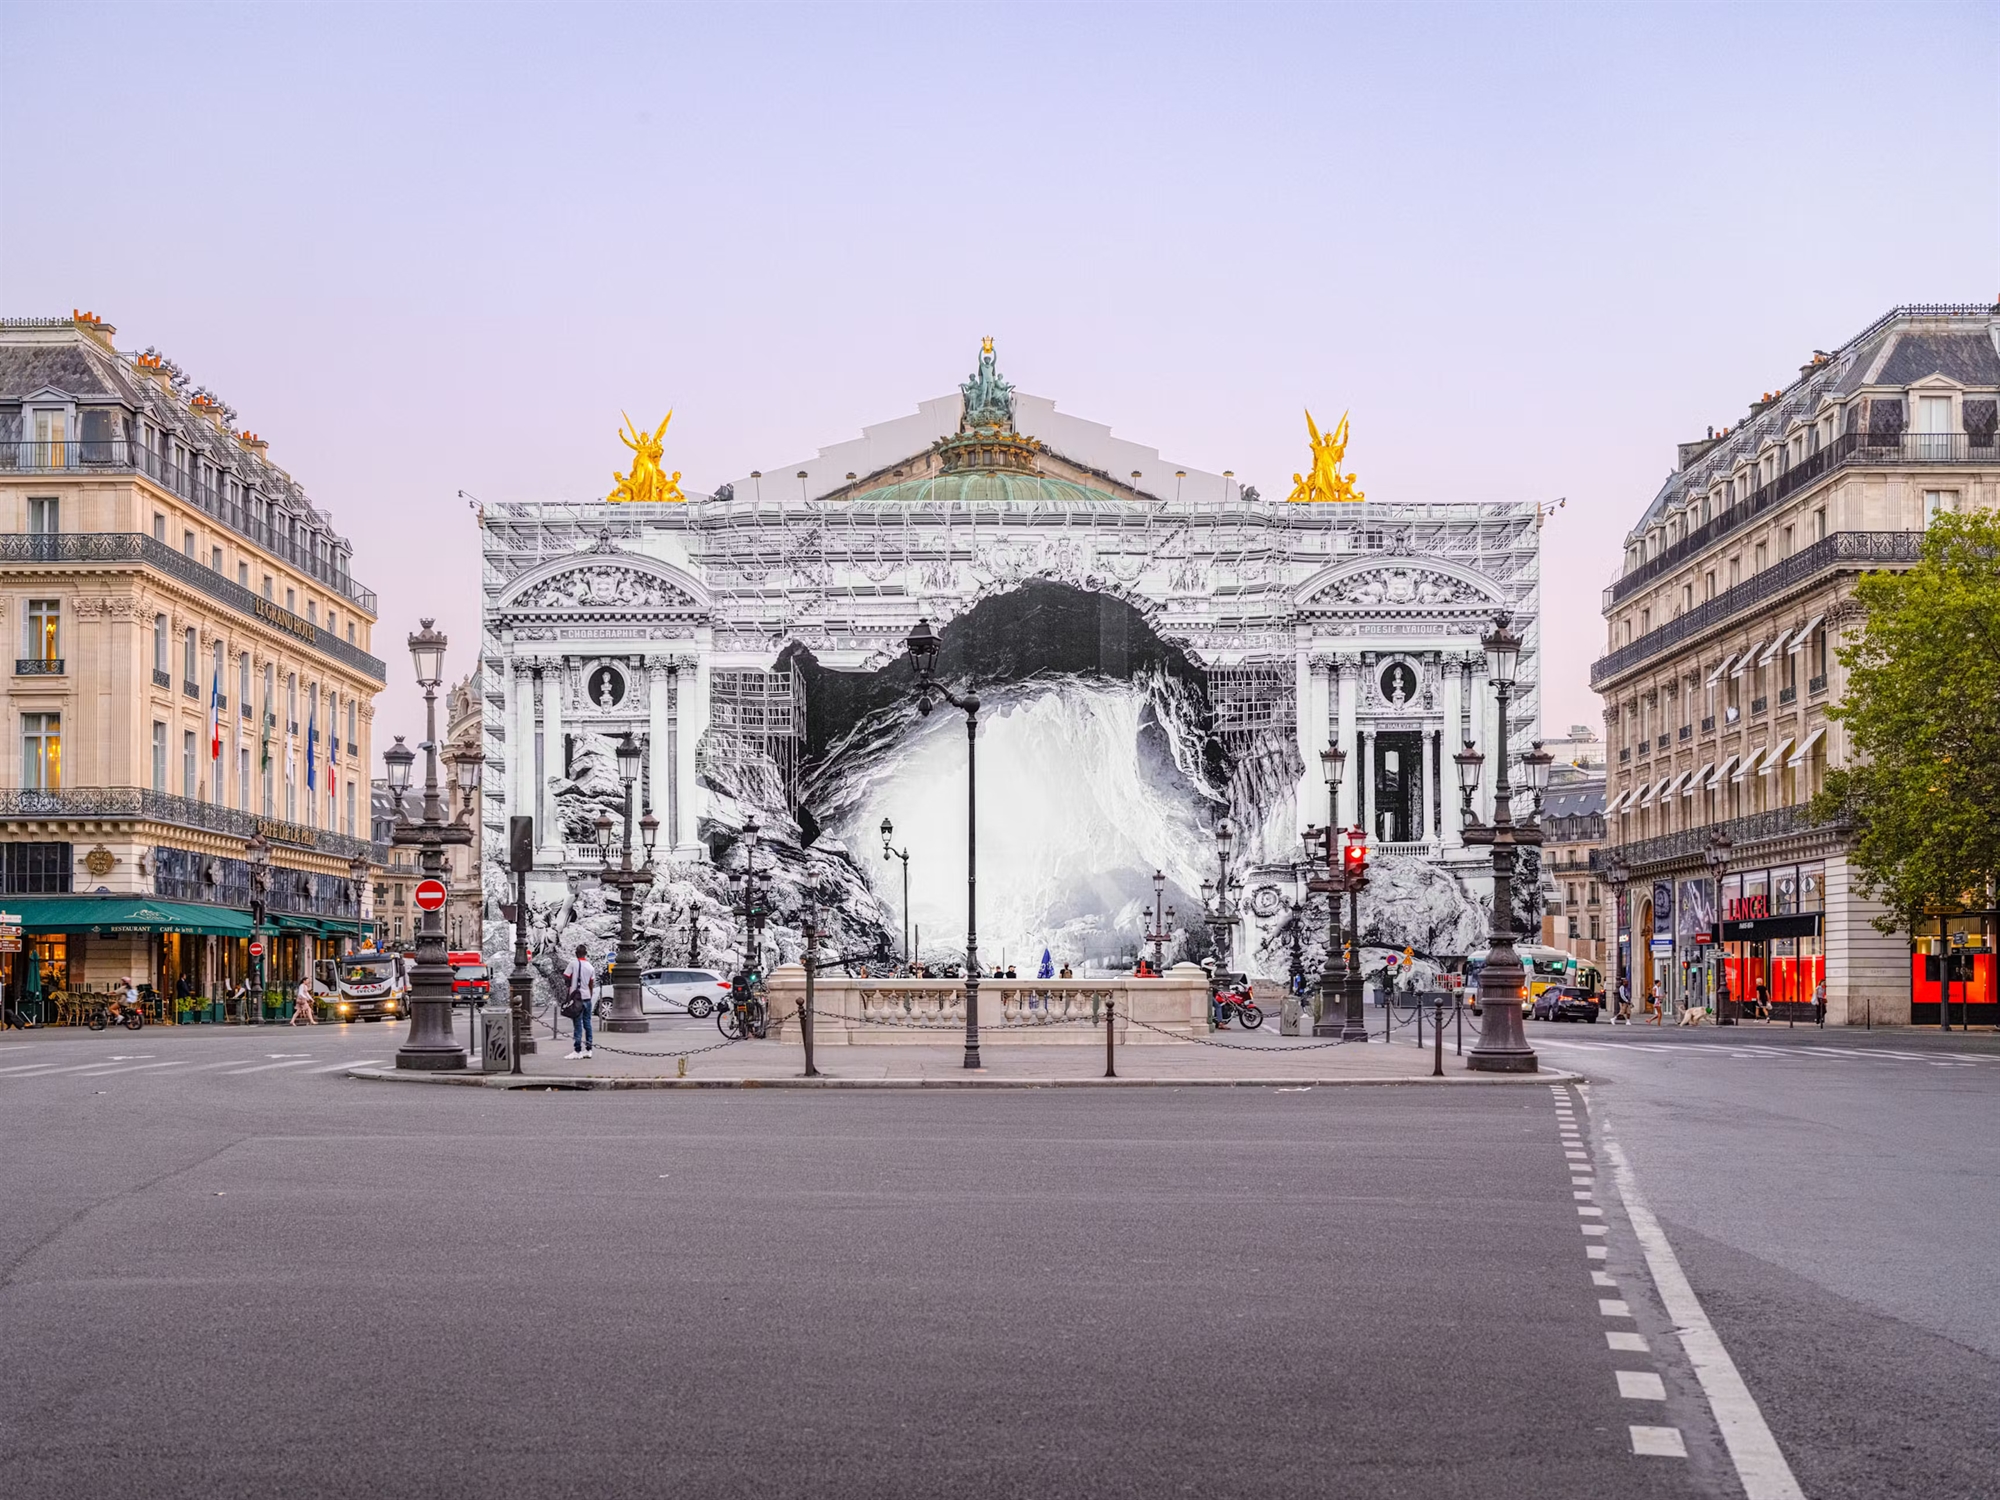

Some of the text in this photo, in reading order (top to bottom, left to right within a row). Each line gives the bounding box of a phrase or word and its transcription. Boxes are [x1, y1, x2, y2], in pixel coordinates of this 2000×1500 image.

[256, 598, 315, 641] LE GRAND HOTEL
[1364, 625, 1438, 634] POESIE LYRIQUE
[568, 629, 638, 638] CHOREGRAPHIE
[280, 823, 288, 840] DE
[290, 826, 299, 842] LA
[302, 828, 316, 846] PAIX
[1728, 894, 1769, 921] LANCEL
